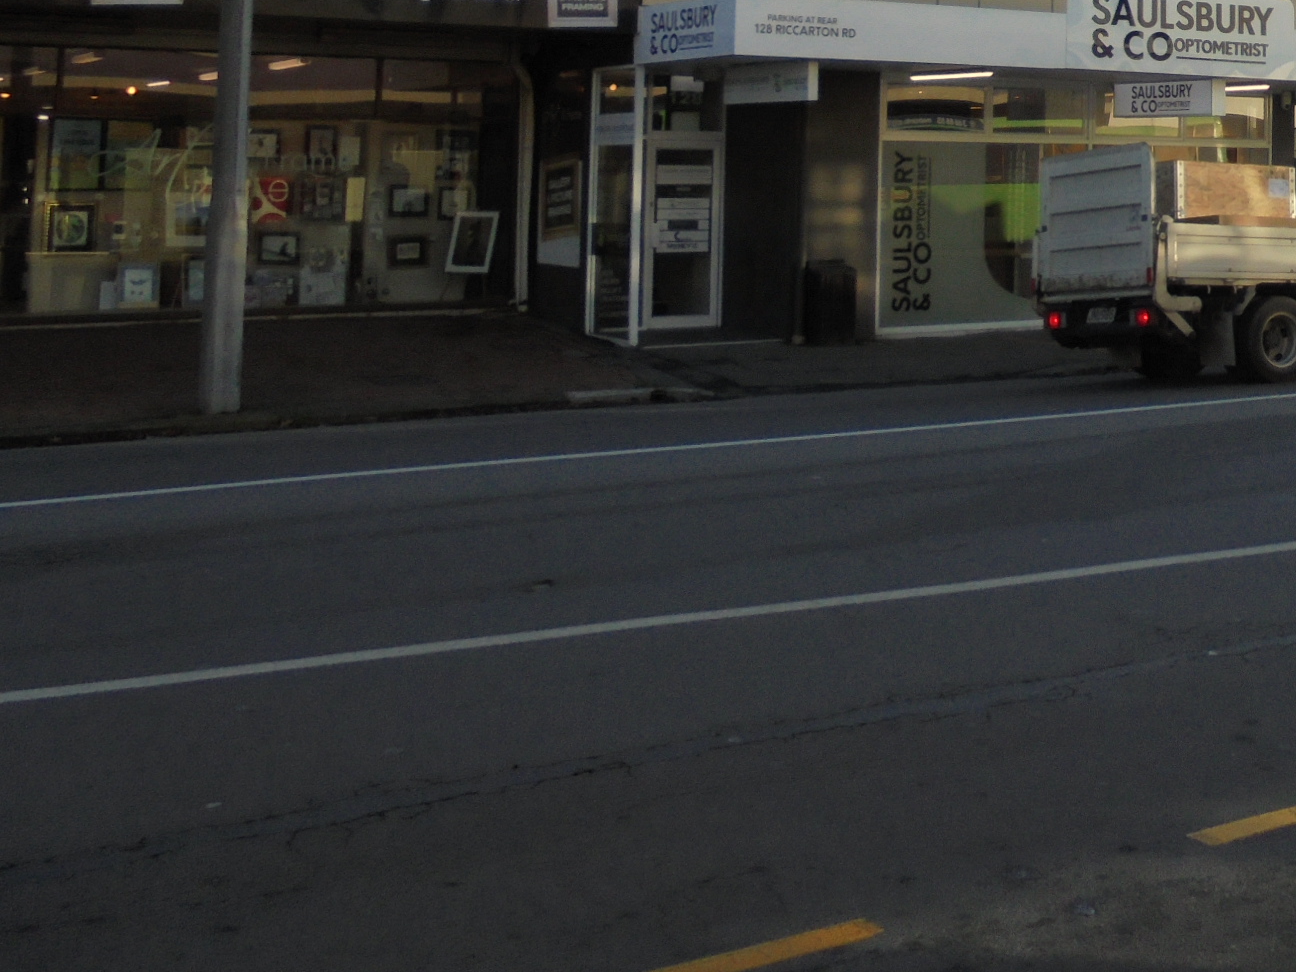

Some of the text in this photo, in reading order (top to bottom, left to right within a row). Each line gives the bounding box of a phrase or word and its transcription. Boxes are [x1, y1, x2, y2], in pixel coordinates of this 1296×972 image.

[562, 2, 604, 12] FRAMING
[650, 4, 718, 34] SAULSBURY
[767, 14, 838, 25] PARKING AT REAR
[755, 23, 856, 38] 128 RICCARTON RD
[650, 36, 658, 55] &
[1091, 28, 1269, 61] & CO OPTOMETRIST
[1131, 84, 1193, 100] SAULSBURY
[1131, 101, 1138, 113] &
[891, 152, 913, 312] SAULSBURY
[913, 293, 931, 311] &
